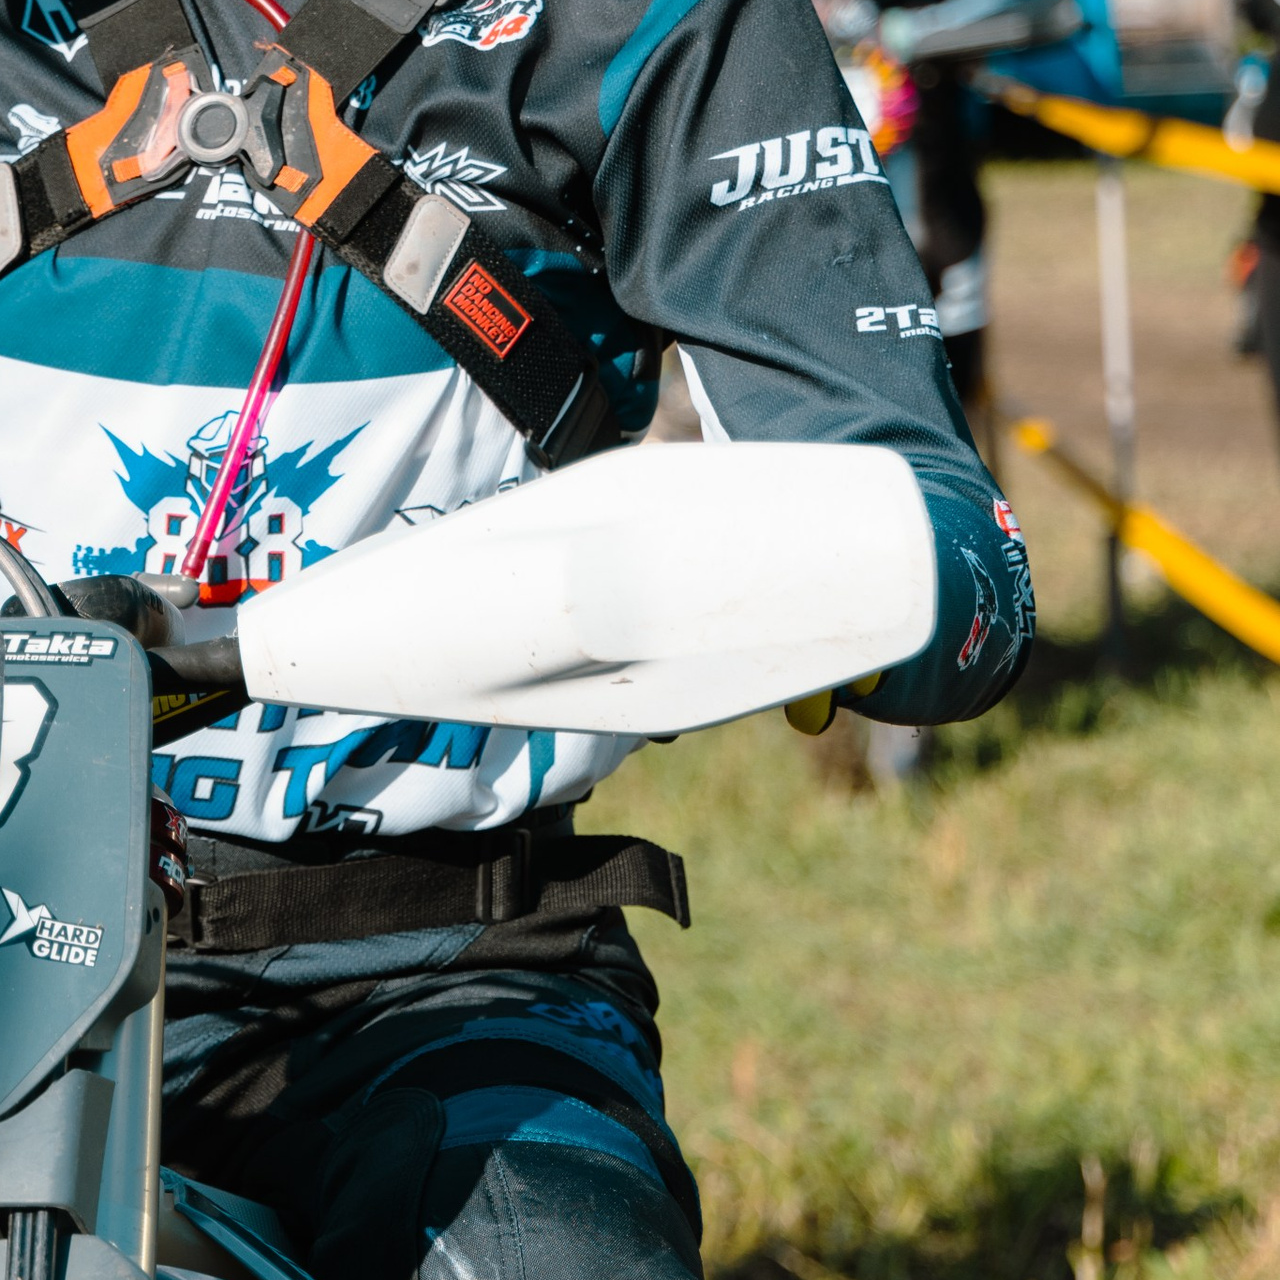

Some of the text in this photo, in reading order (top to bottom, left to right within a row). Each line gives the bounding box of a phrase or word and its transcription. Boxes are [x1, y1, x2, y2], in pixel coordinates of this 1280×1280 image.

[738, 177, 834, 212] RACING
[468, 273, 493, 295] NO
[452, 293, 509, 345] MONKEY
[460, 283, 518, 338] DANCING
[5, 634, 113, 656] Takta
[5, 653, 90, 663] motoservice
[36, 919, 102, 947] HARD
[31, 937, 98, 967] GLIDE
